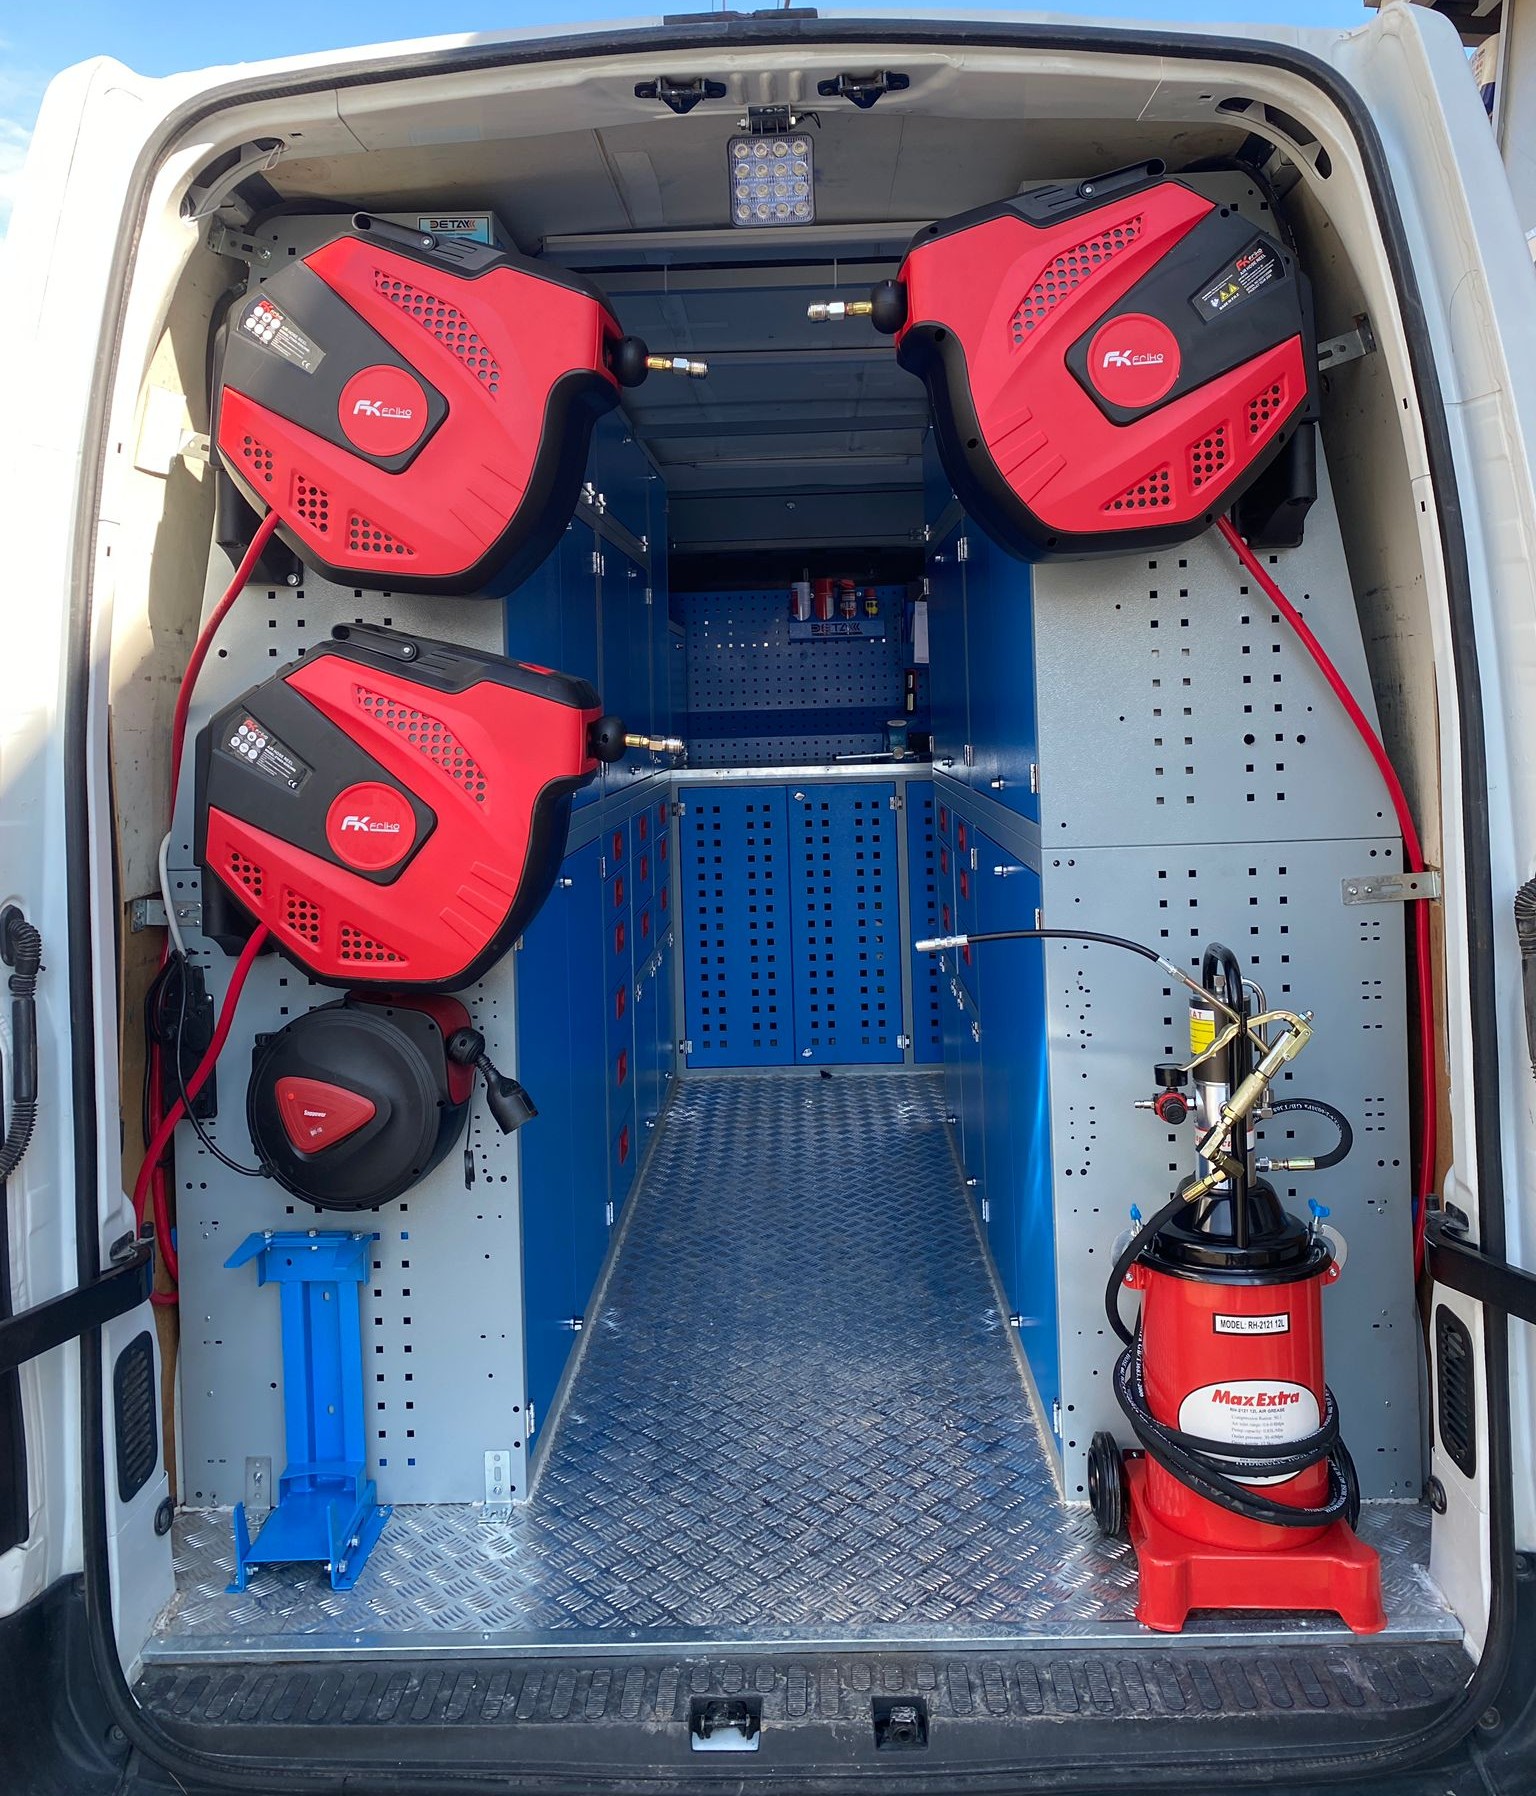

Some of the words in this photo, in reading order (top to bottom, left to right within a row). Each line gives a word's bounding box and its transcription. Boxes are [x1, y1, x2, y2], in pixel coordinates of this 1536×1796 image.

[1103, 350, 1132, 368] FK
[353, 399, 383, 416] FK
[341, 816, 371, 832] FK
[1220, 1319, 1247, 1329] MODEL:
[1248, 1320, 1273, 1329] RH-2121
[1275, 1319, 1285, 1328] 12L
